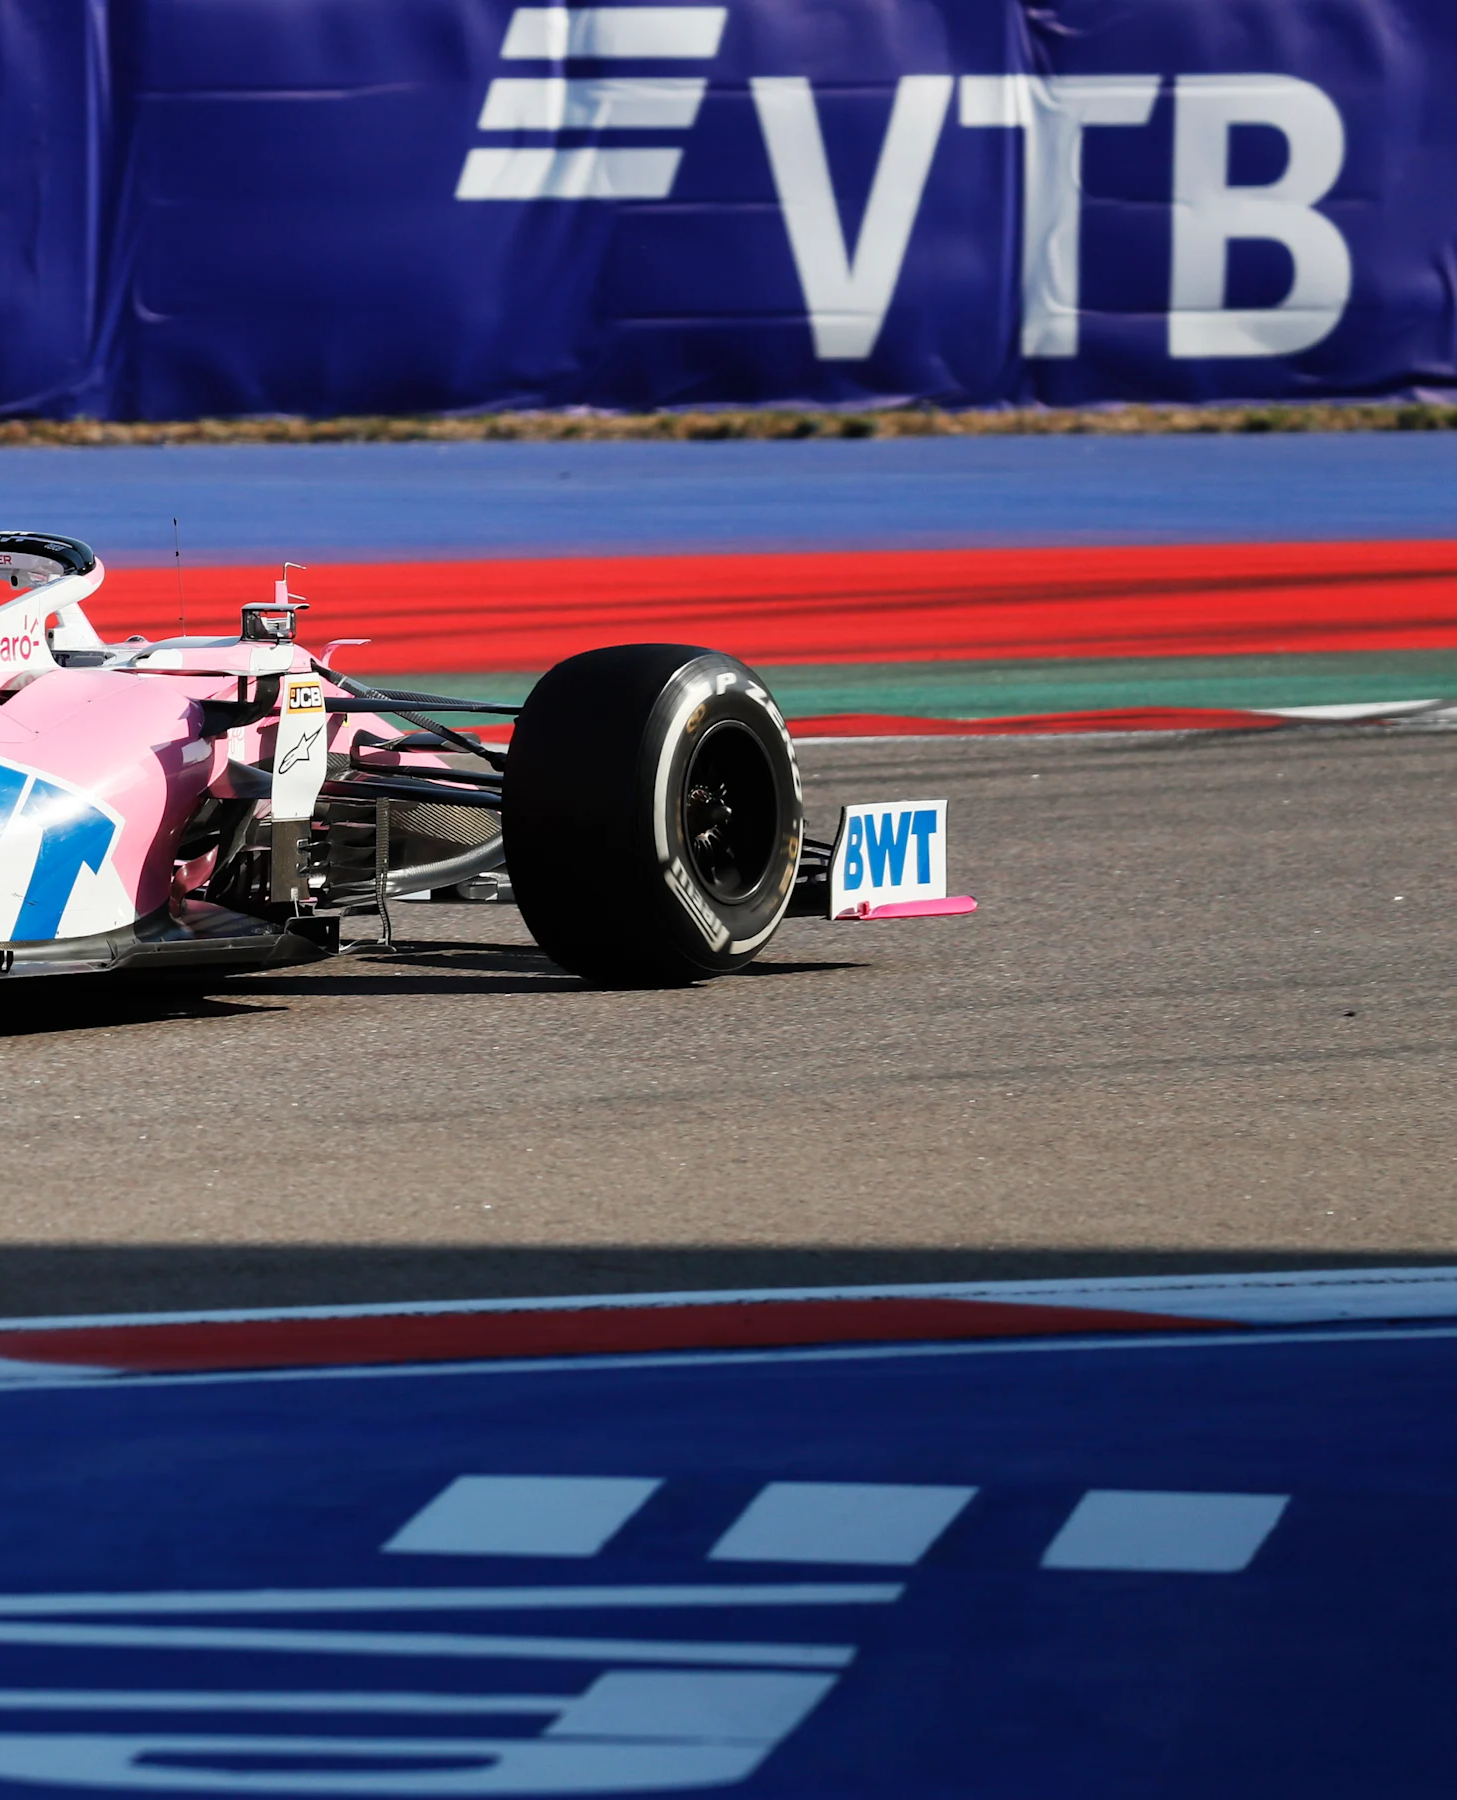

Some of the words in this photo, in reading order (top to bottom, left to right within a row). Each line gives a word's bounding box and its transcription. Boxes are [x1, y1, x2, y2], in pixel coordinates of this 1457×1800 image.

[749, 74, 1351, 360] VTB
[290, 687, 323, 709] JCB
[844, 809, 938, 891] BWT
